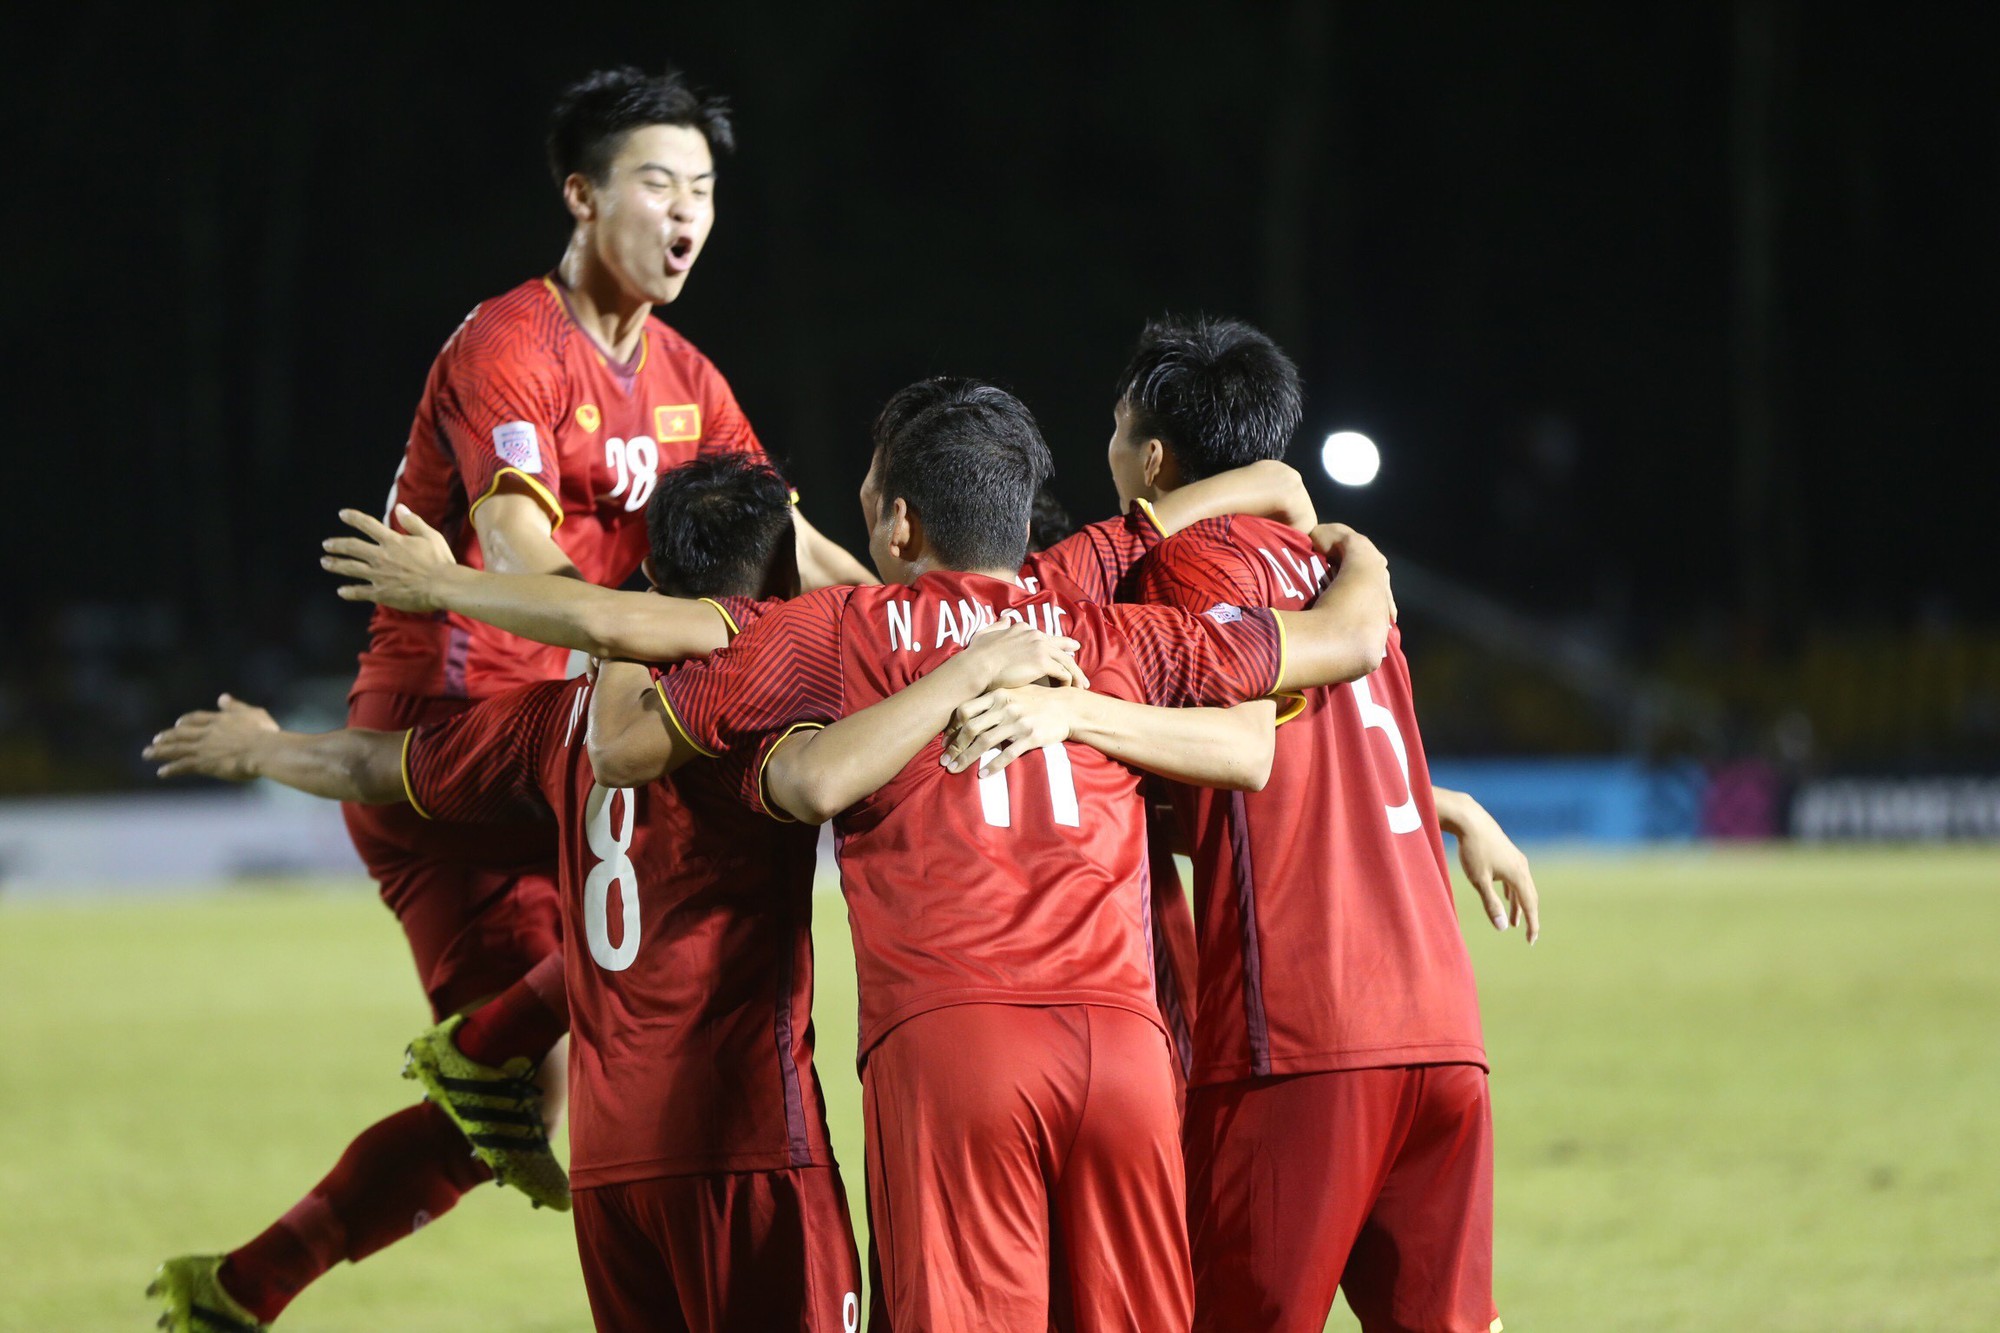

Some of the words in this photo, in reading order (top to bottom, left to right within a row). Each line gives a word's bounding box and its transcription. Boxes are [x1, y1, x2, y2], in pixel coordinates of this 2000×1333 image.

[886, 600, 921, 652] N.
[1351, 645, 1422, 834] 5
[584, 783, 641, 971] 8
